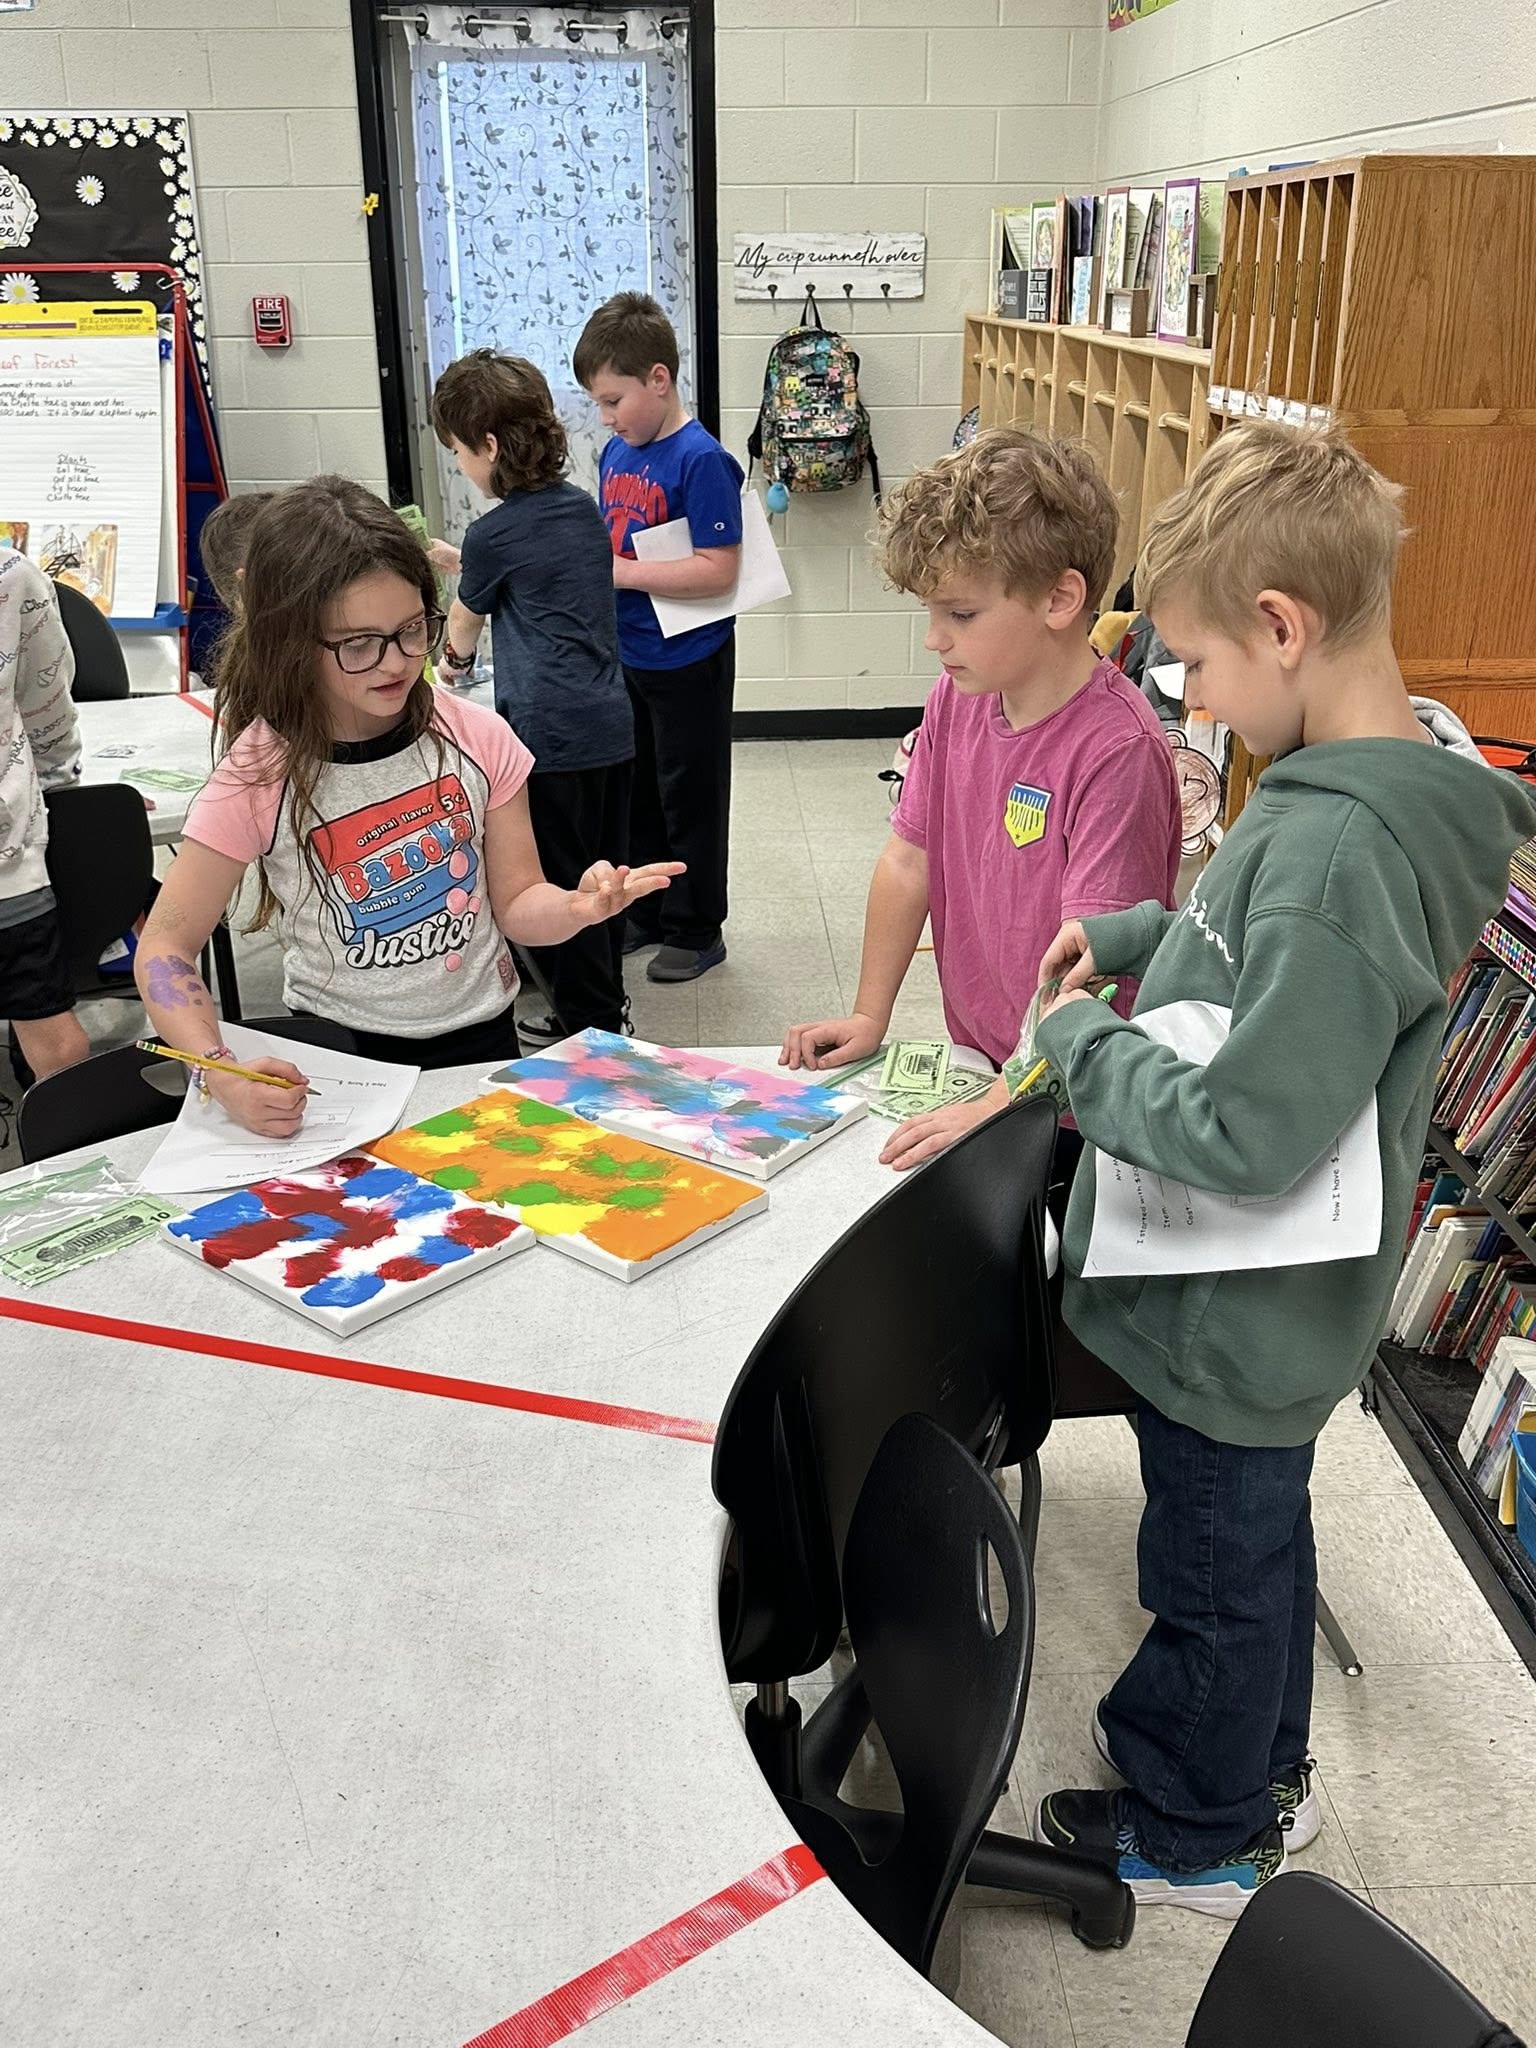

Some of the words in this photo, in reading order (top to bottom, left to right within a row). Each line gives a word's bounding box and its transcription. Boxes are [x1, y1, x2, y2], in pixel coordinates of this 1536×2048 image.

[738, 242, 773, 279] My
[776, 251, 807, 275] cup
[808, 239, 885, 267] runneth
[885, 247, 922, 263] over
[255, 299, 282, 309] FIRE
[0, 355, 21, 370] eaf
[34, 353, 79, 370] Forest
[357, 818, 399, 847] original
[400, 803, 434, 823] flavor
[335, 816, 473, 902] Bazooka
[358, 895, 400, 915] bubble
[403, 881, 426, 901] gum
[345, 911, 477, 970] Justice
[1332, 1168, 1341, 1190] have
[1137, 1186, 1145, 1204] with
[149, 1211, 171, 1223] 10
[1140, 1206, 1148, 1237] started
[1332, 1207, 1341, 1223] Now
